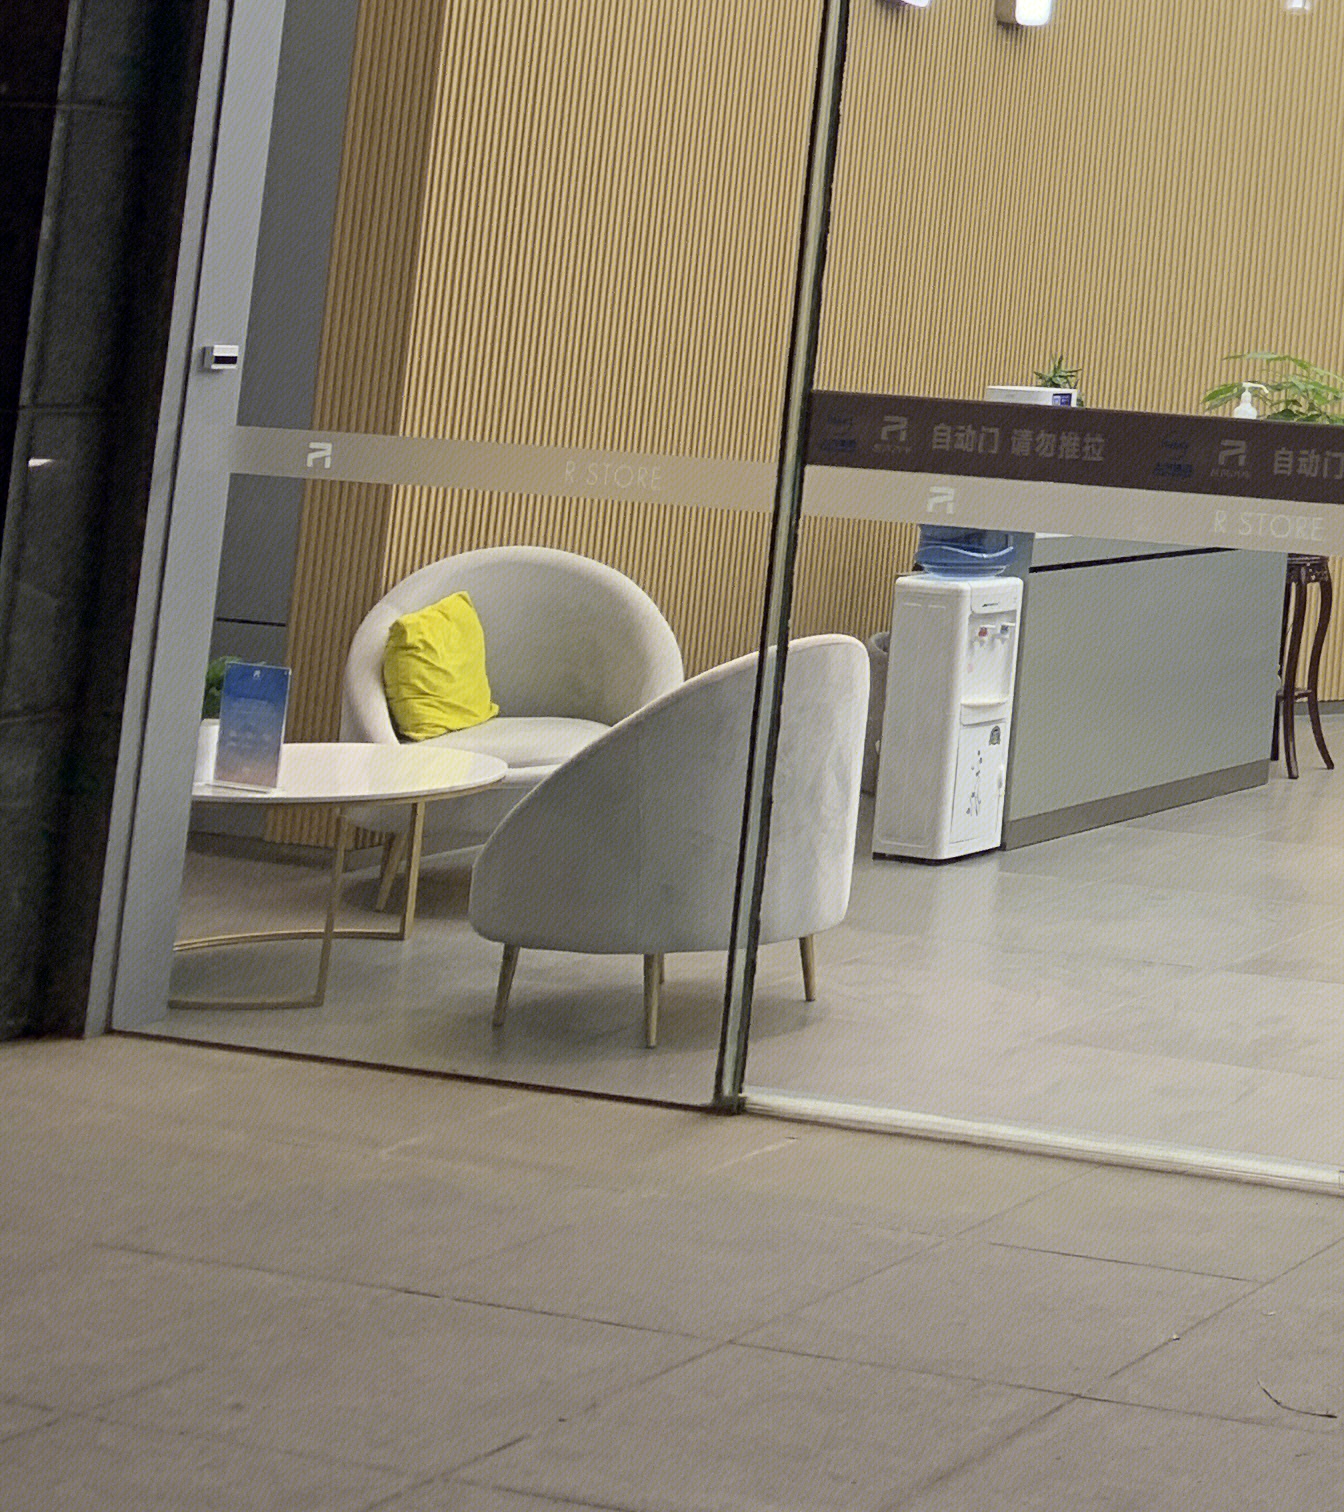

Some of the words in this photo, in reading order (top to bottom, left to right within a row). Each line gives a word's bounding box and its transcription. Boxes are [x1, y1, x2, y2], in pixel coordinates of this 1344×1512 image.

[931, 422, 1000, 455] 自动门
[1010, 429, 1106, 462] 请勿推拉
[565, 460, 576, 484] R
[585, 463, 662, 491] STORE
[1273, 447, 1344, 479] 自动门
[1213, 509, 1227, 534] R
[1238, 512, 1325, 542] STORE
